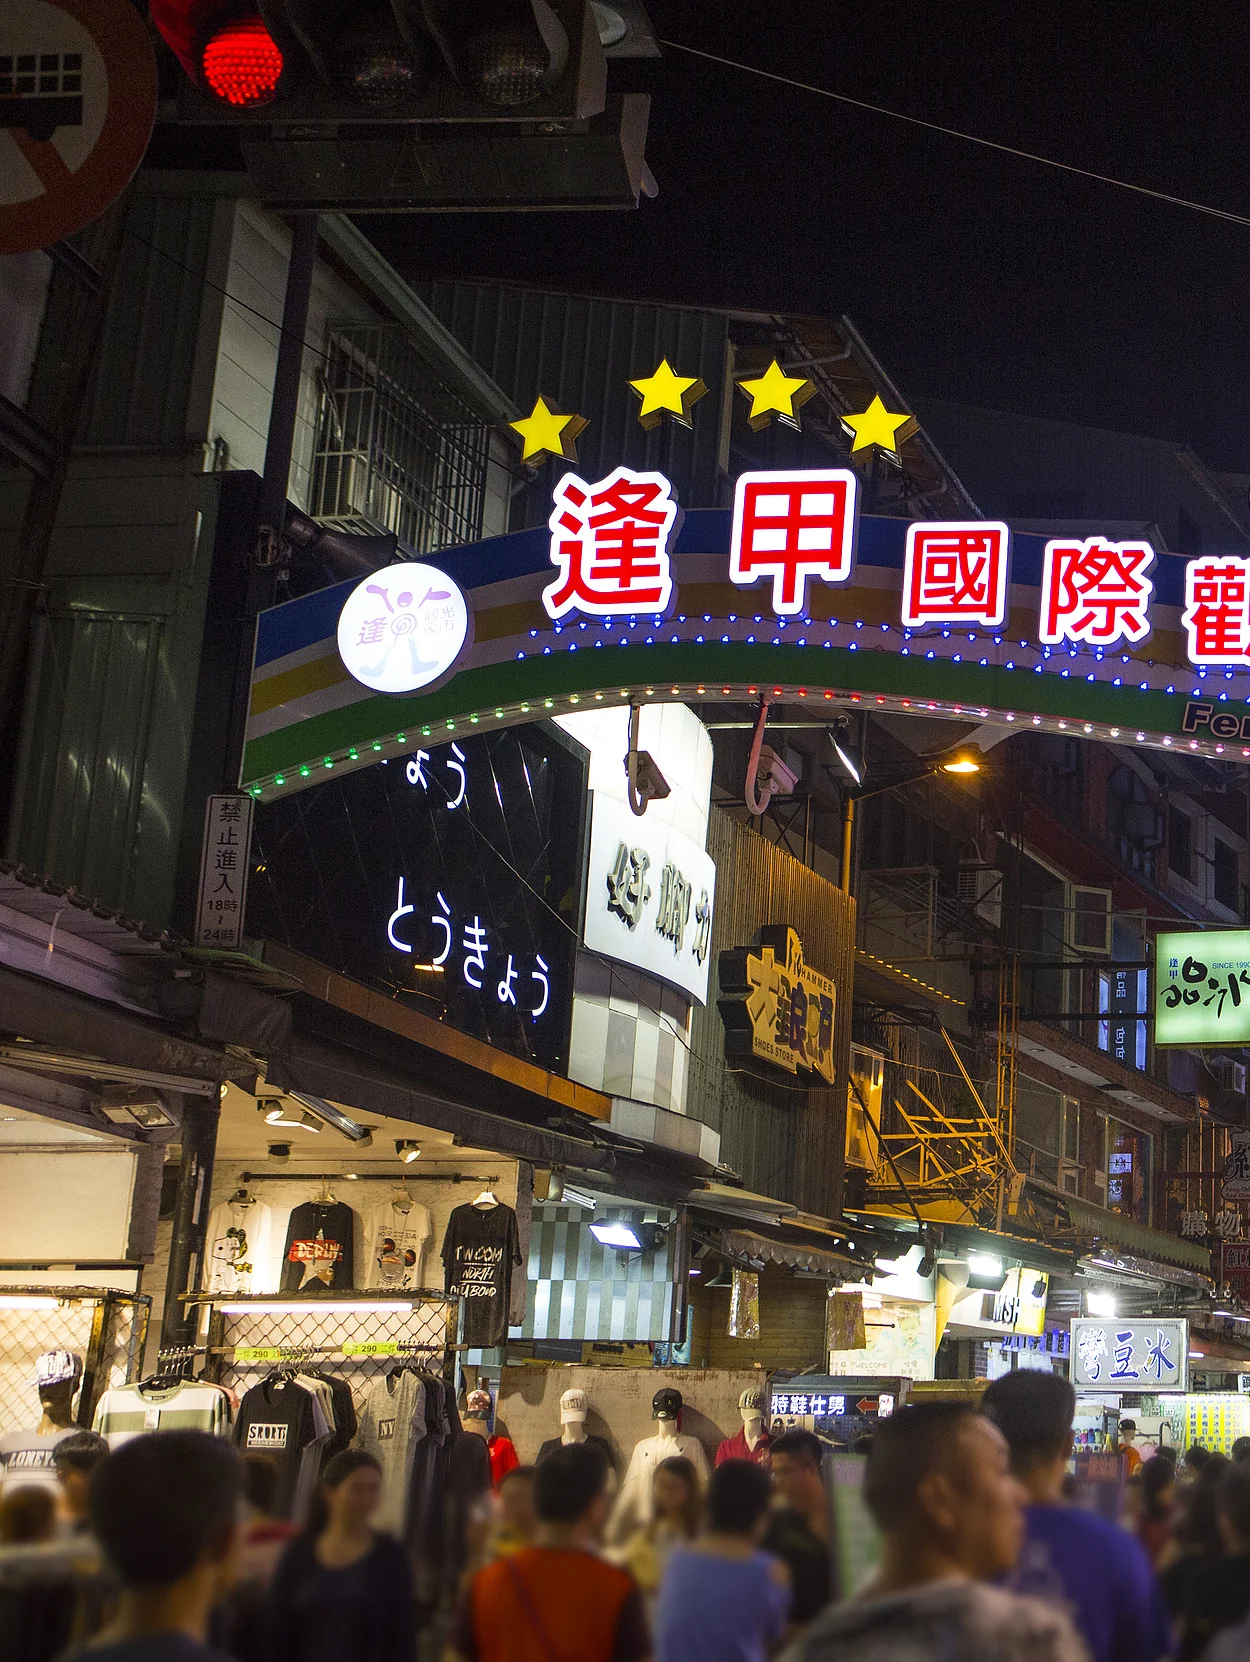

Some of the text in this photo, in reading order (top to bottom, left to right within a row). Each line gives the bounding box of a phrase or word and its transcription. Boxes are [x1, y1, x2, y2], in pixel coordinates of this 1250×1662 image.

[214, 801, 241, 893] 禁止進入
[387, 876, 550, 1017] とうきょう
[802, 968, 833, 995] HAMMER
[1169, 958, 1178, 979] 逢甲
[754, 1037, 795, 1065] SHOES STORE
[381, 1421, 395, 1435] NY
